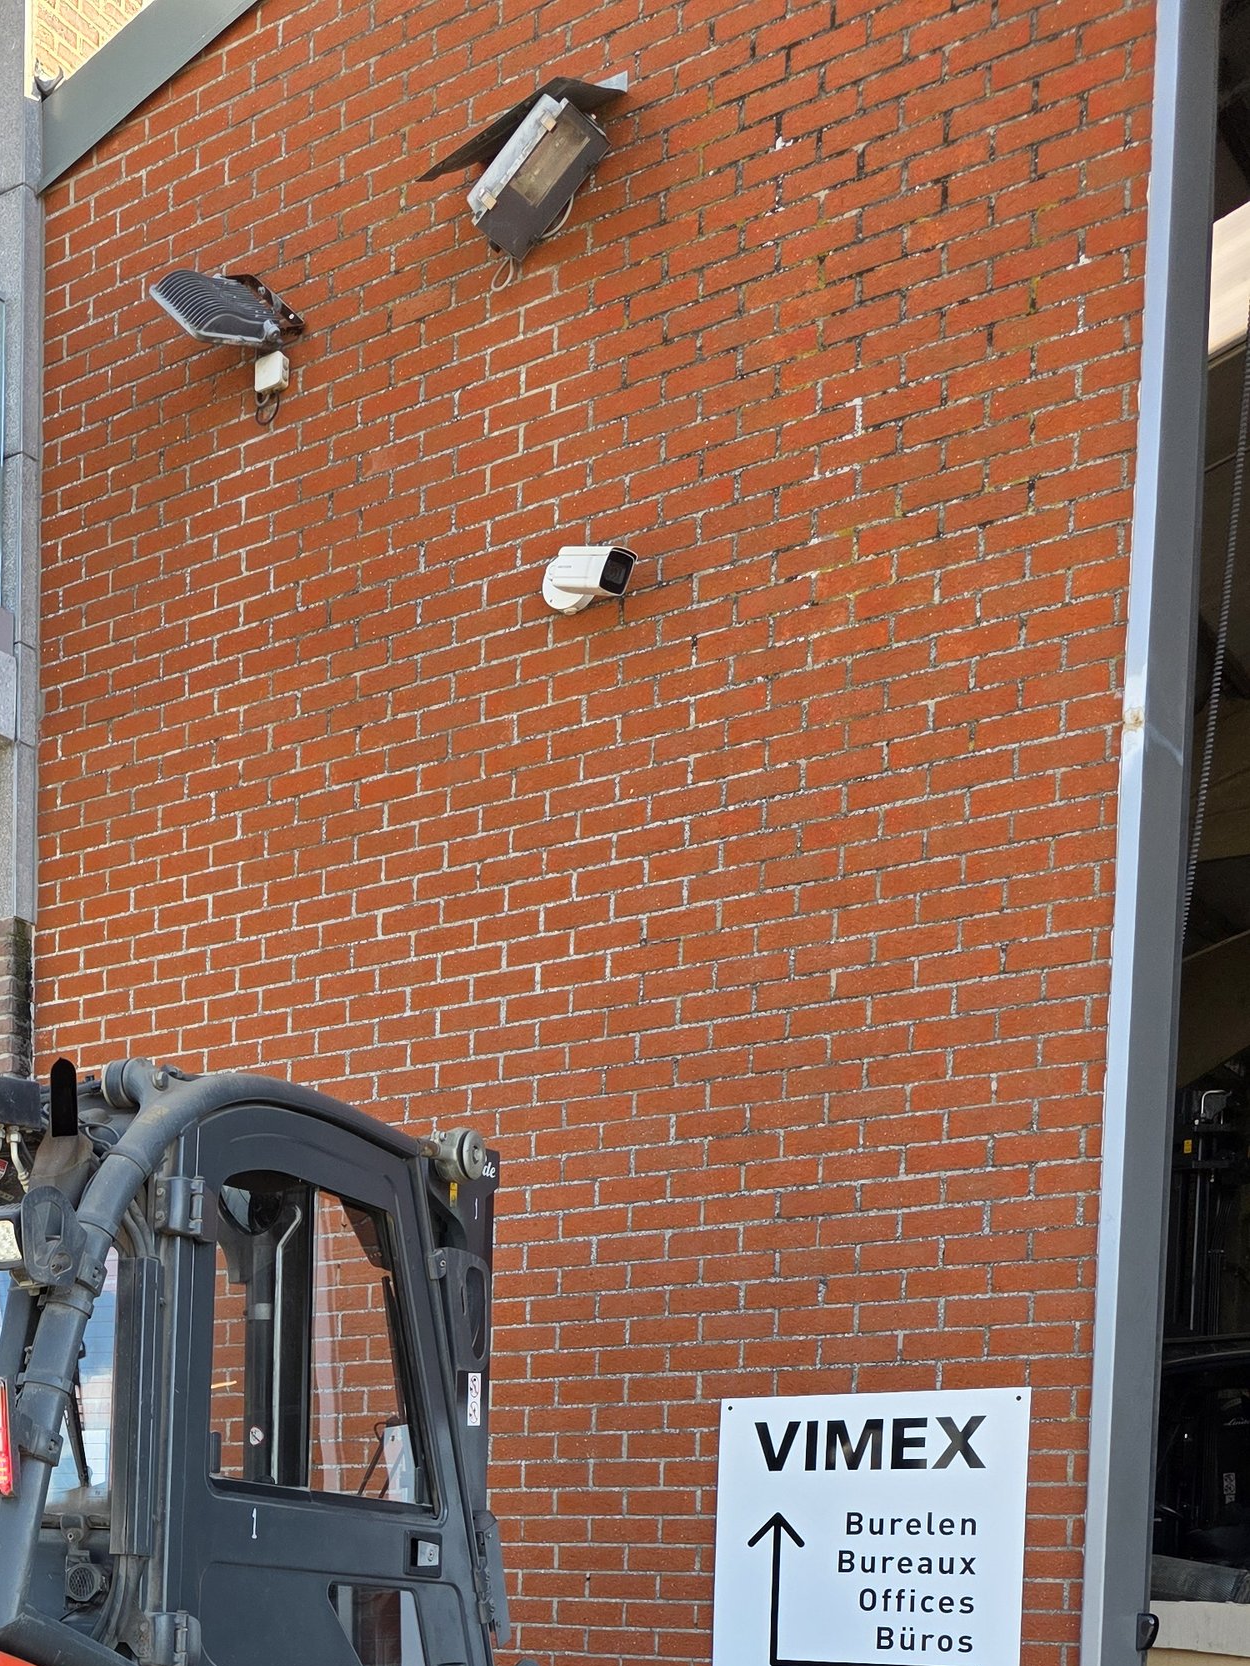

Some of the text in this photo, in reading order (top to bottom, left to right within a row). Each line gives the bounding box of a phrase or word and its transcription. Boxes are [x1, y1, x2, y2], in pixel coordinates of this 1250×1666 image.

[482, 1161, 496, 1178] de
[754, 1415, 987, 1471] VIMEX
[845, 1511, 978, 1536] Burelen
[837, 1550, 977, 1575] Bureaux
[859, 1588, 975, 1614] Offices
[876, 1626, 973, 1653] Büros
